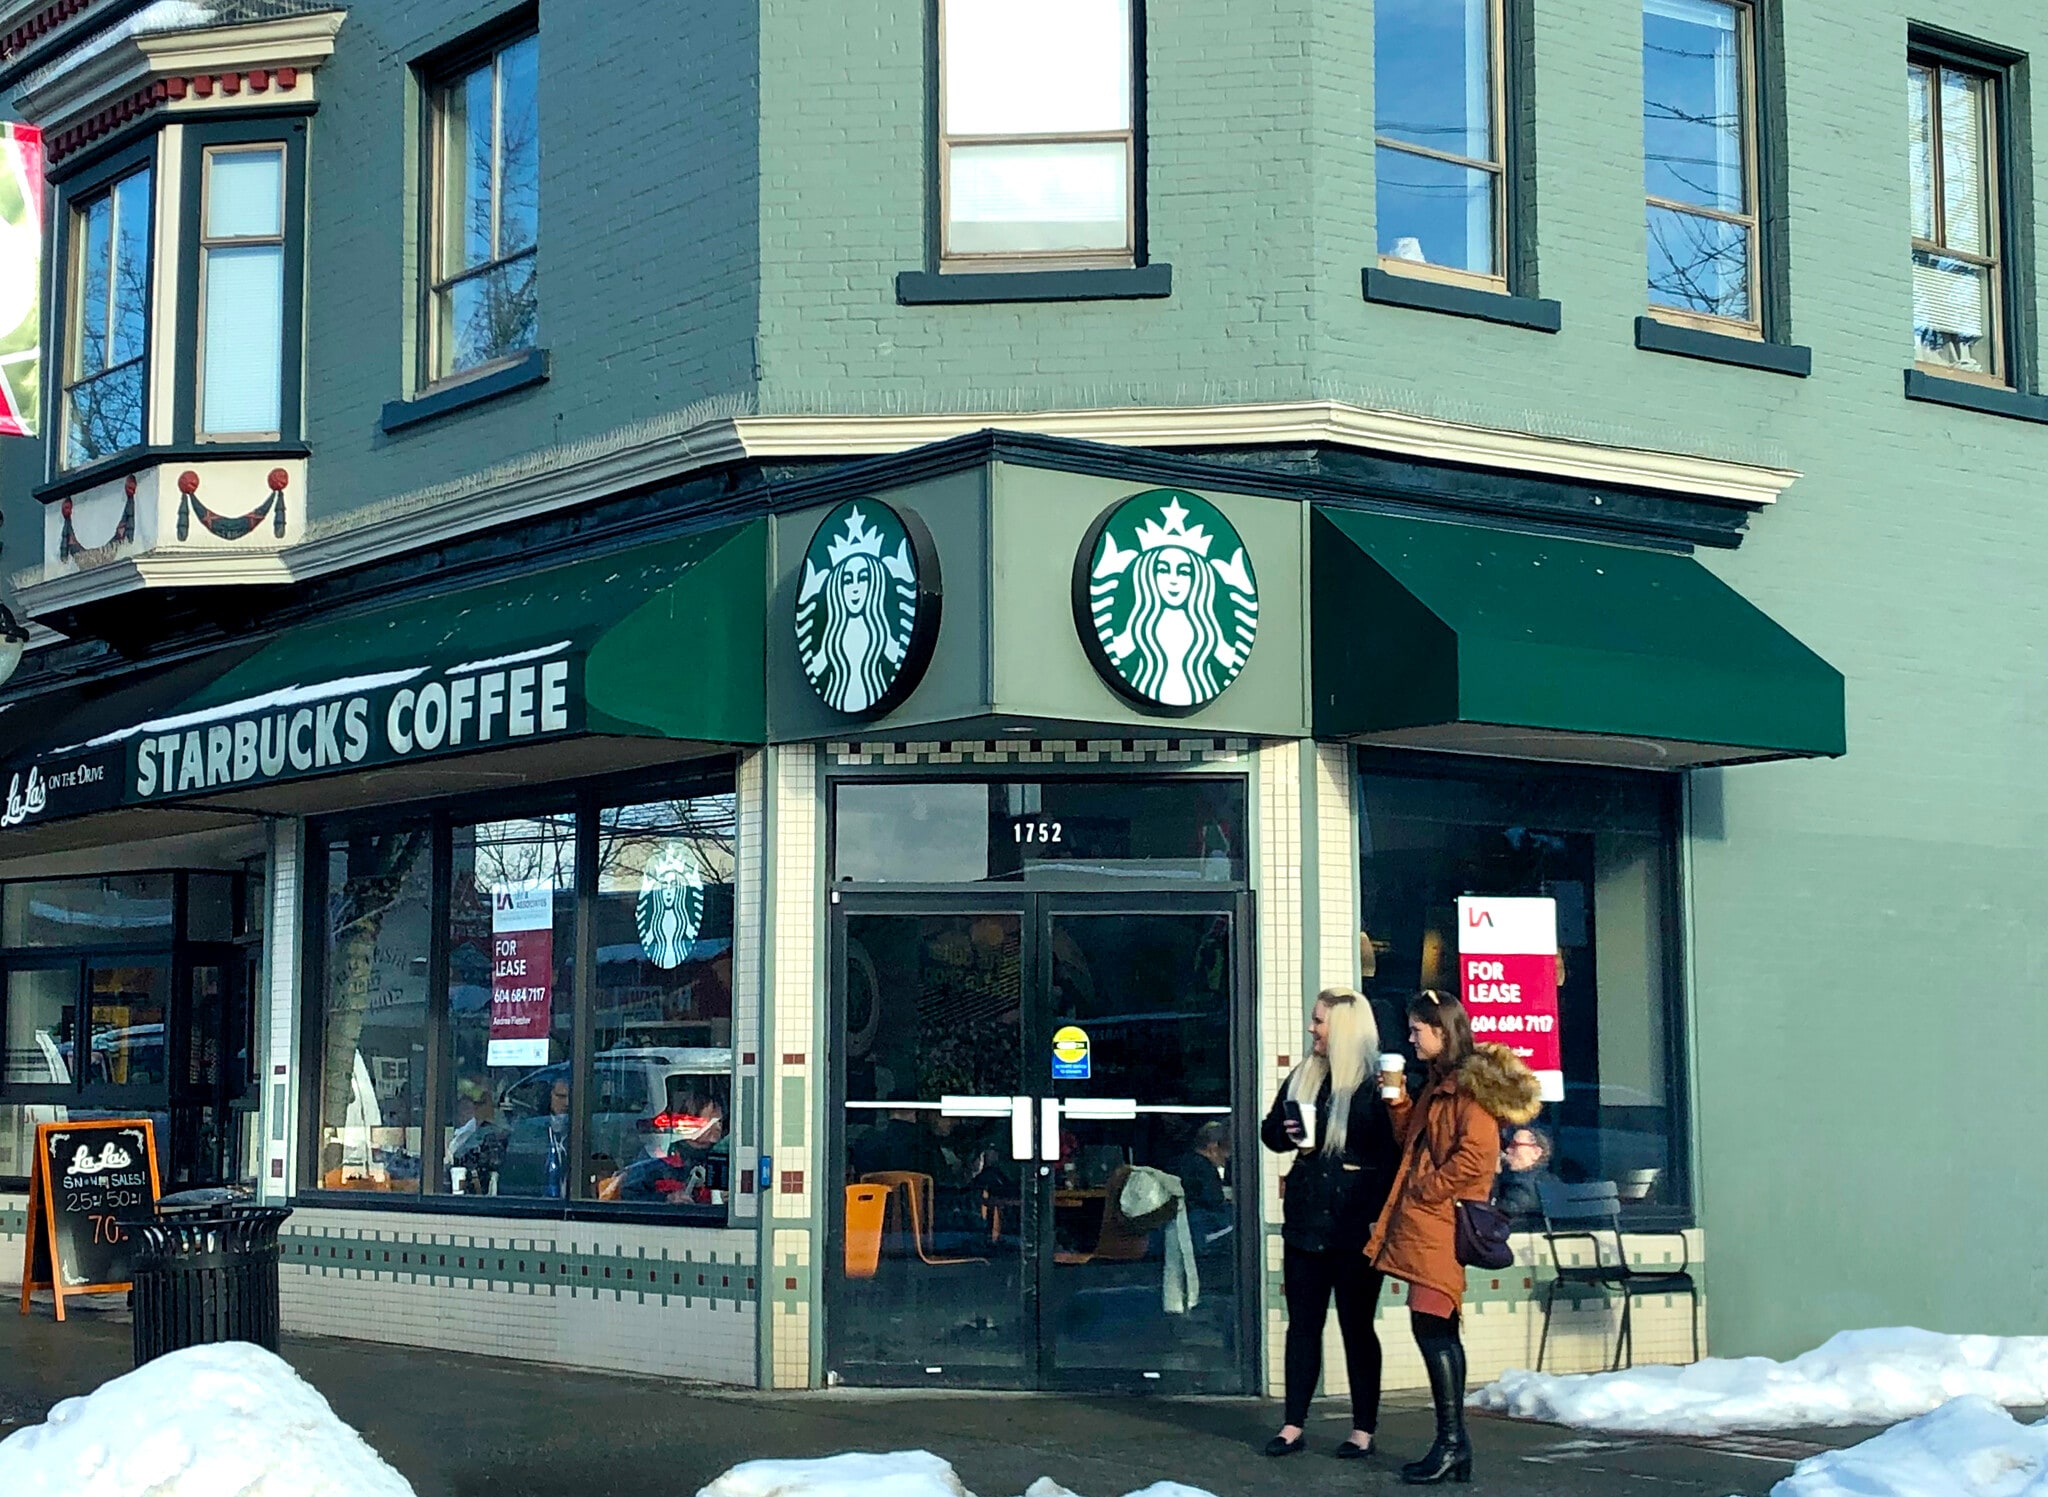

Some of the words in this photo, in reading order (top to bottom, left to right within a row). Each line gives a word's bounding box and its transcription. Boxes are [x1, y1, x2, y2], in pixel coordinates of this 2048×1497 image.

[137, 697, 369, 797] STARBUCKS
[387, 660, 568, 754] COFFEE
[48, 775, 60, 789] ON
[62, 771, 76, 787] THE
[77, 764, 104, 784] DRIVE
[1013, 822, 1062, 843] 1752
[495, 940, 517, 956] FOR
[495, 959, 527, 977] LEASE
[1467, 961, 1504, 980] FOR
[494, 988, 510, 1003] 604
[511, 987, 527, 1002] 684
[528, 986, 546, 1001] 7117
[1468, 984, 1522, 1003] LEASE
[1470, 1015, 1497, 1032] 604
[1498, 1015, 1524, 1032] 684
[111, 1170, 145, 1187] SALES!
